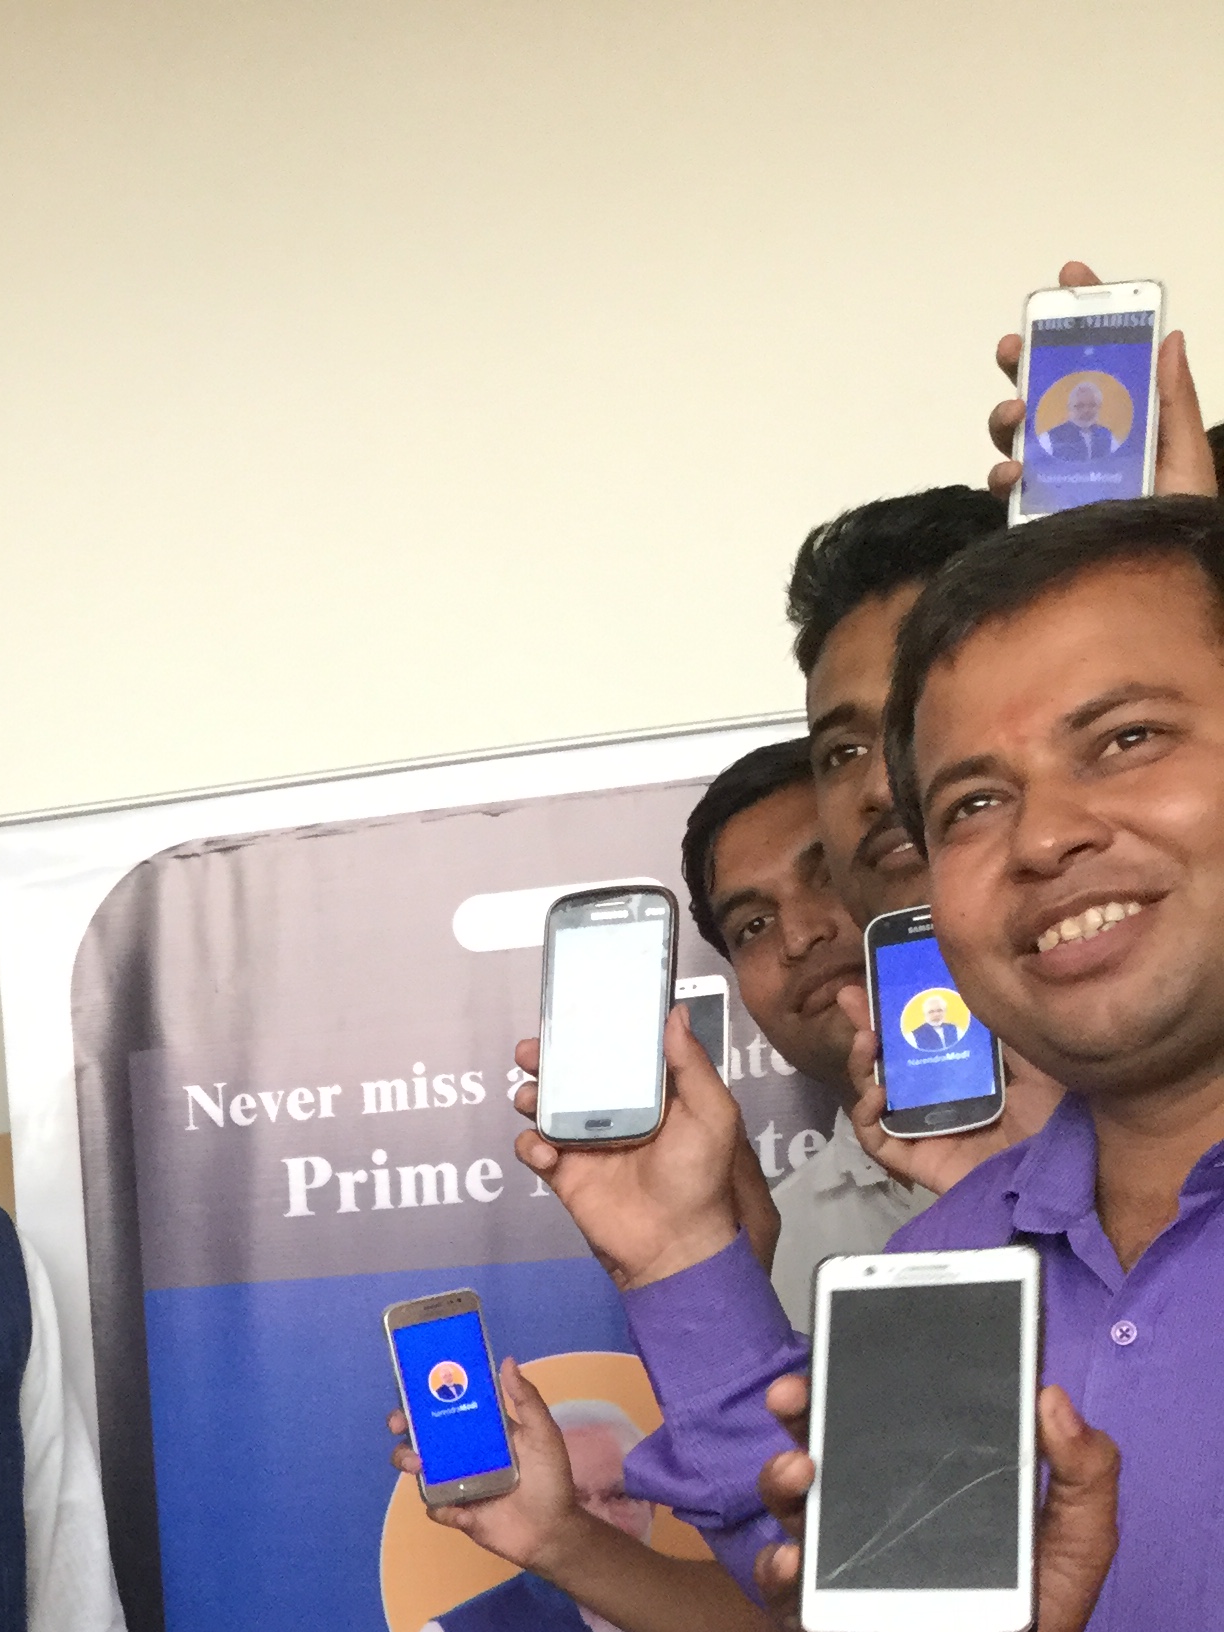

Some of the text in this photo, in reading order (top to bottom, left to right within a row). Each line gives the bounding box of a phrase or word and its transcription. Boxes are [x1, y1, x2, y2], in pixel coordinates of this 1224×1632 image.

[183, 1082, 342, 1131] Never
[361, 1061, 486, 1115] miss
[281, 1148, 504, 1218] Prime
